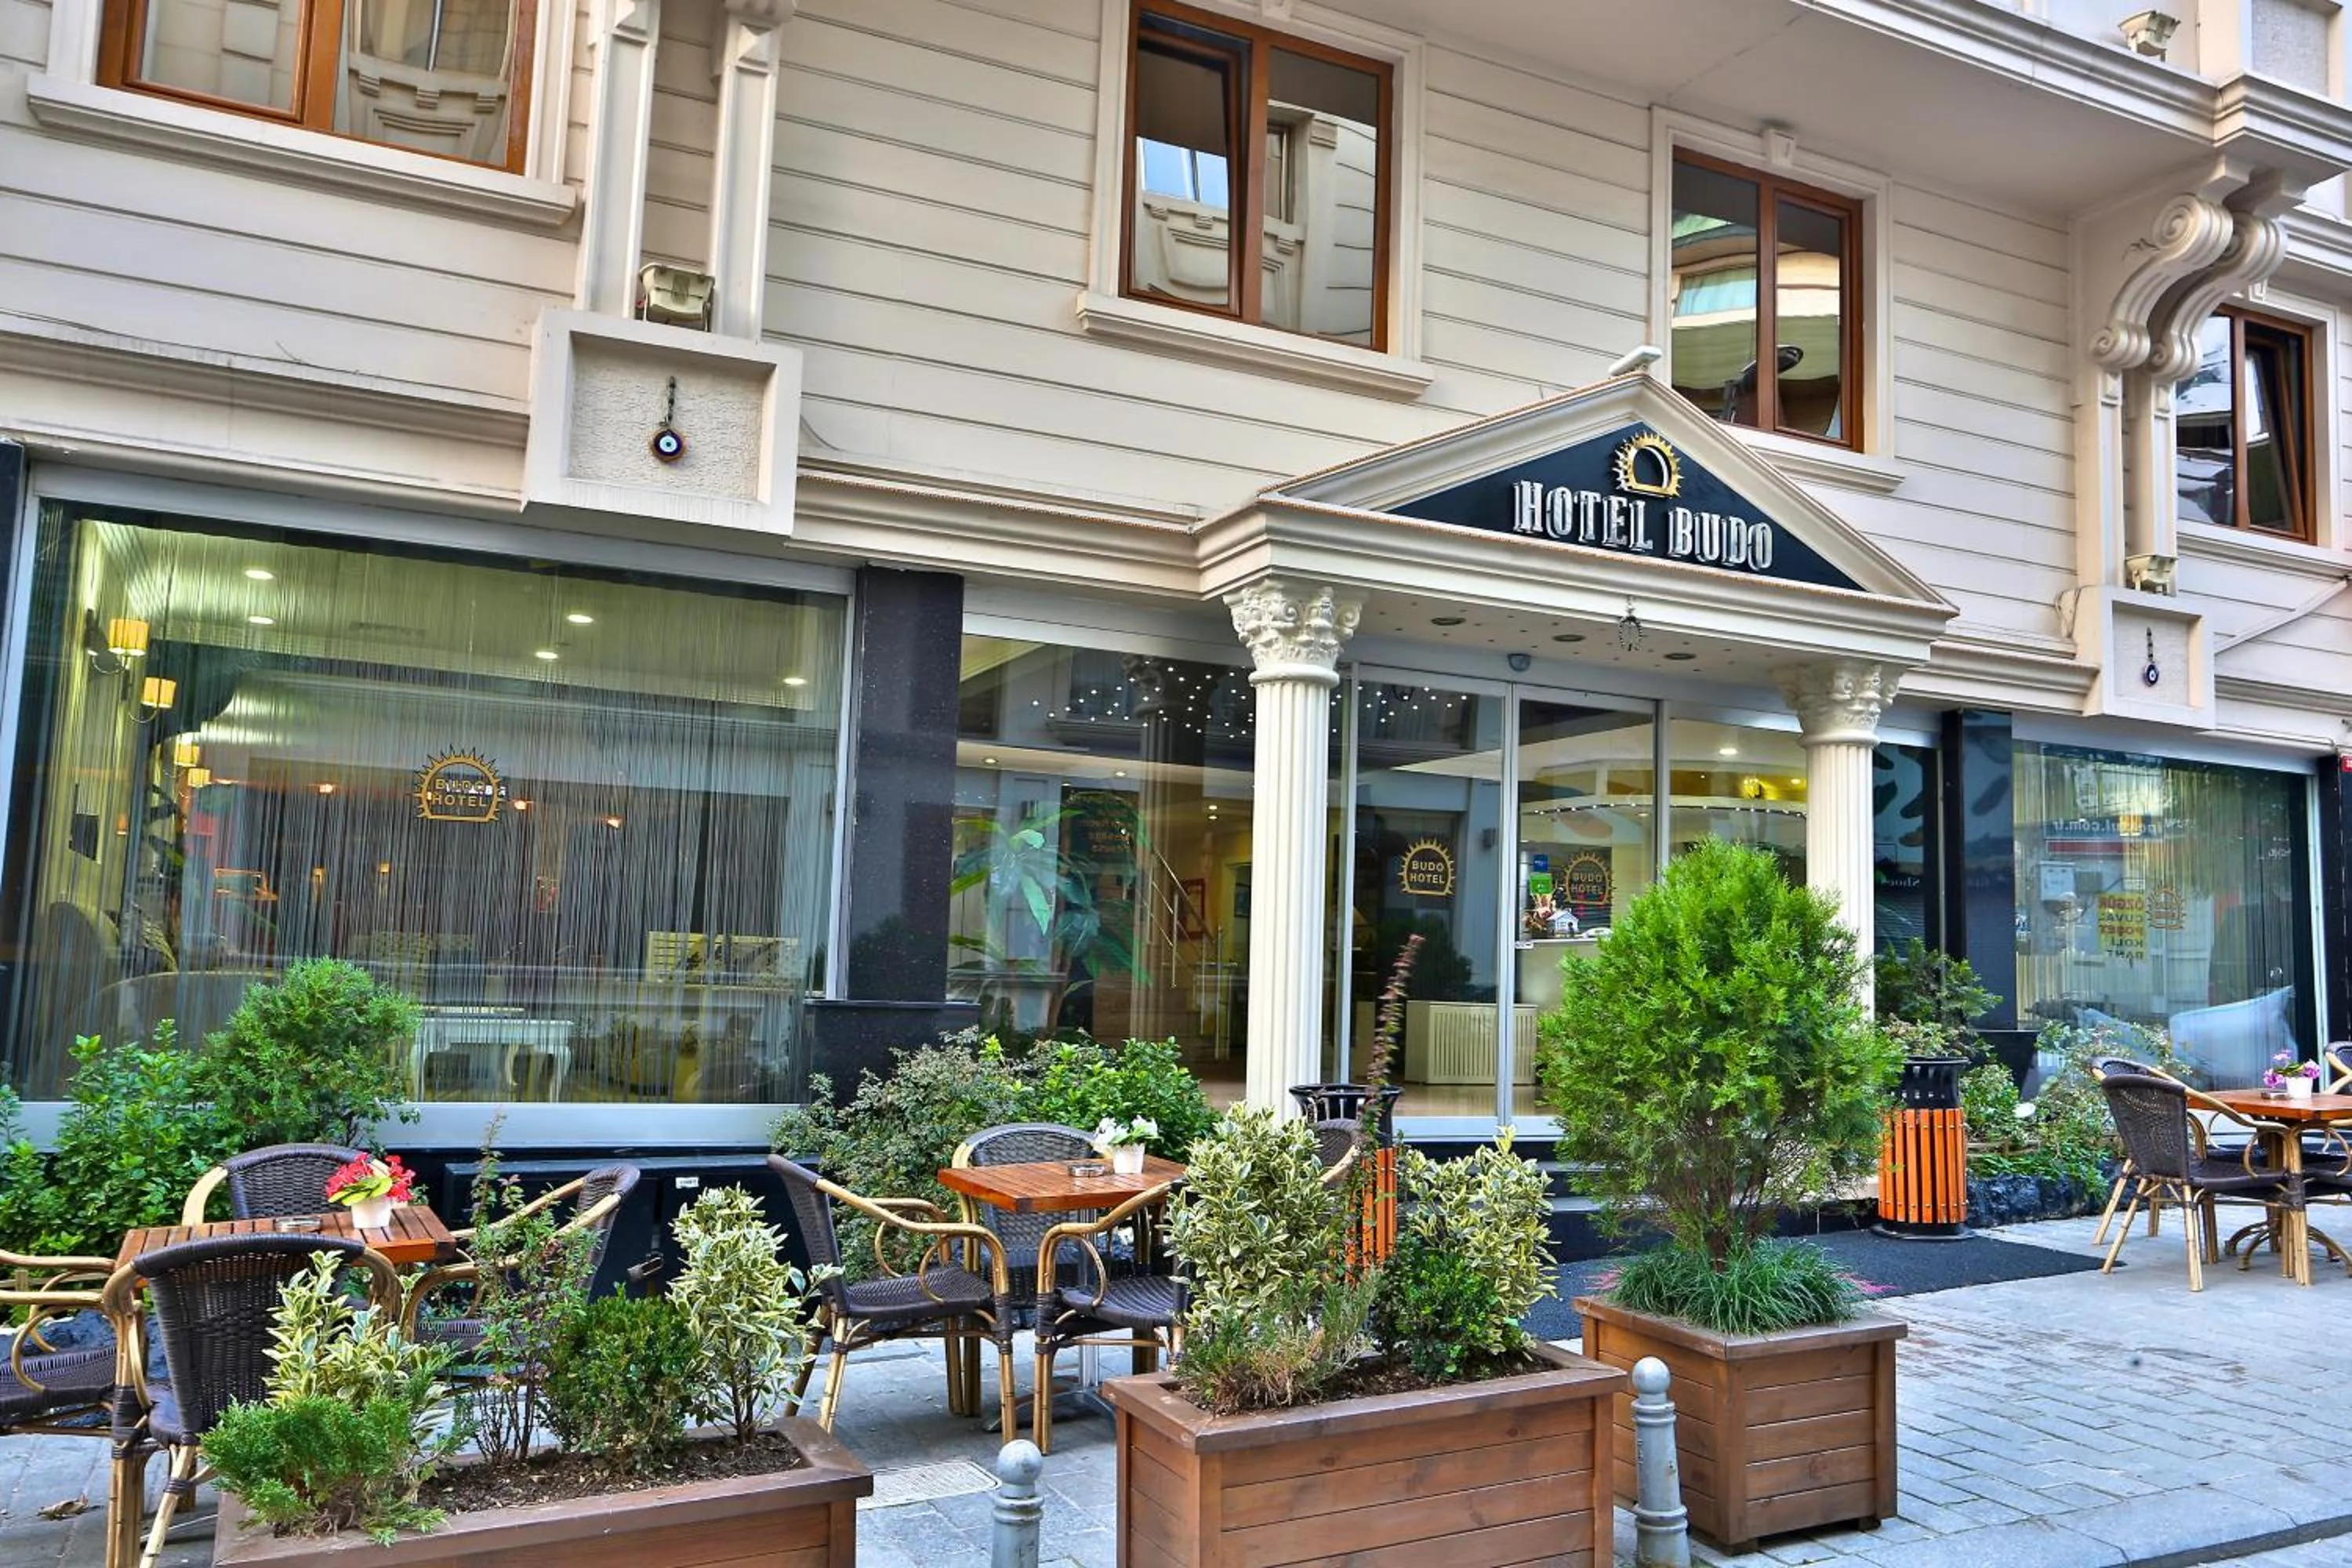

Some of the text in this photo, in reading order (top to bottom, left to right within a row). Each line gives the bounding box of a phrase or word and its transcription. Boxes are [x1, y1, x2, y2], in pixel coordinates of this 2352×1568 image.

[1512, 480, 1773, 571] HOTEL BUDO
[432, 794, 487, 807] HOTEL
[1412, 861, 1444, 872] BUDO
[1410, 873, 1446, 884] HOTEL
[1571, 884, 1603, 893] HOTEL
